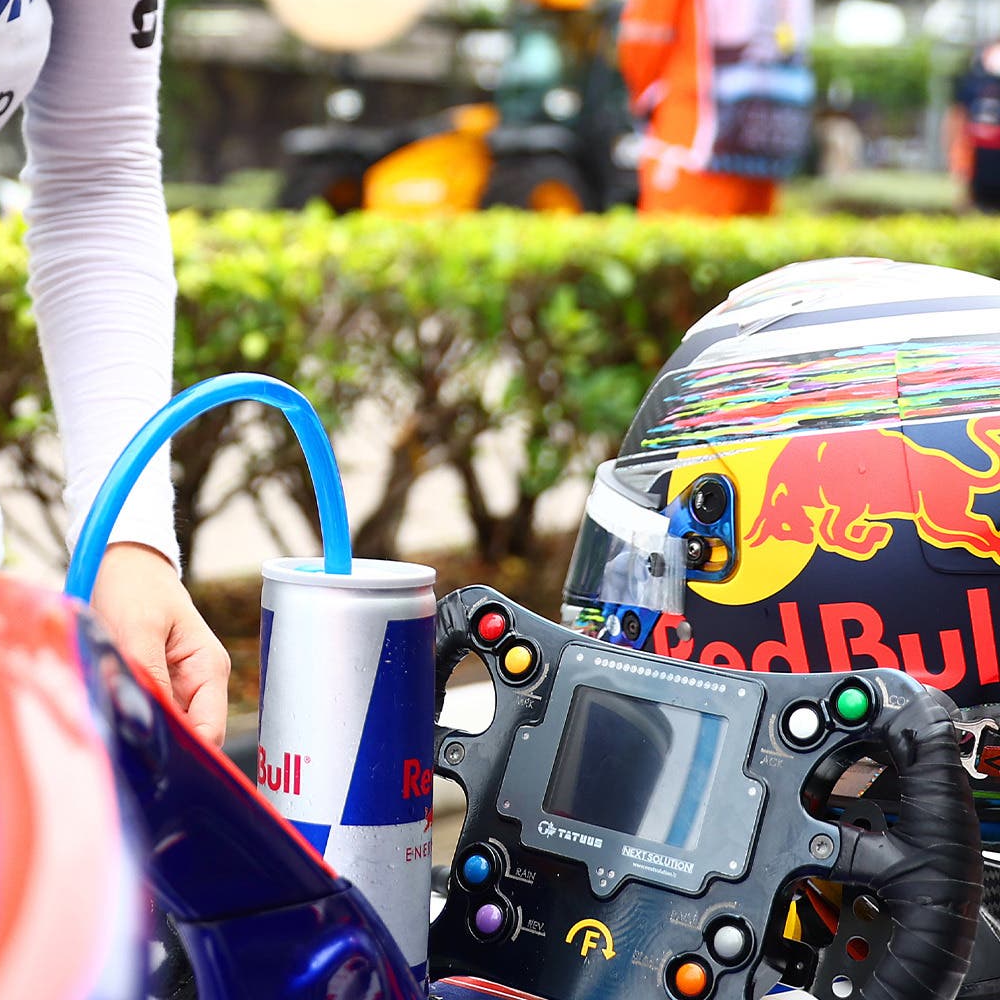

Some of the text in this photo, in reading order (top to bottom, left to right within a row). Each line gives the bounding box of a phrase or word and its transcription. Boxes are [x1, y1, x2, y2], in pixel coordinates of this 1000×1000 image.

[402, 758, 434, 799] Re
[557, 828, 604, 849] TATUUS
[515, 867, 537, 881] RAIN
